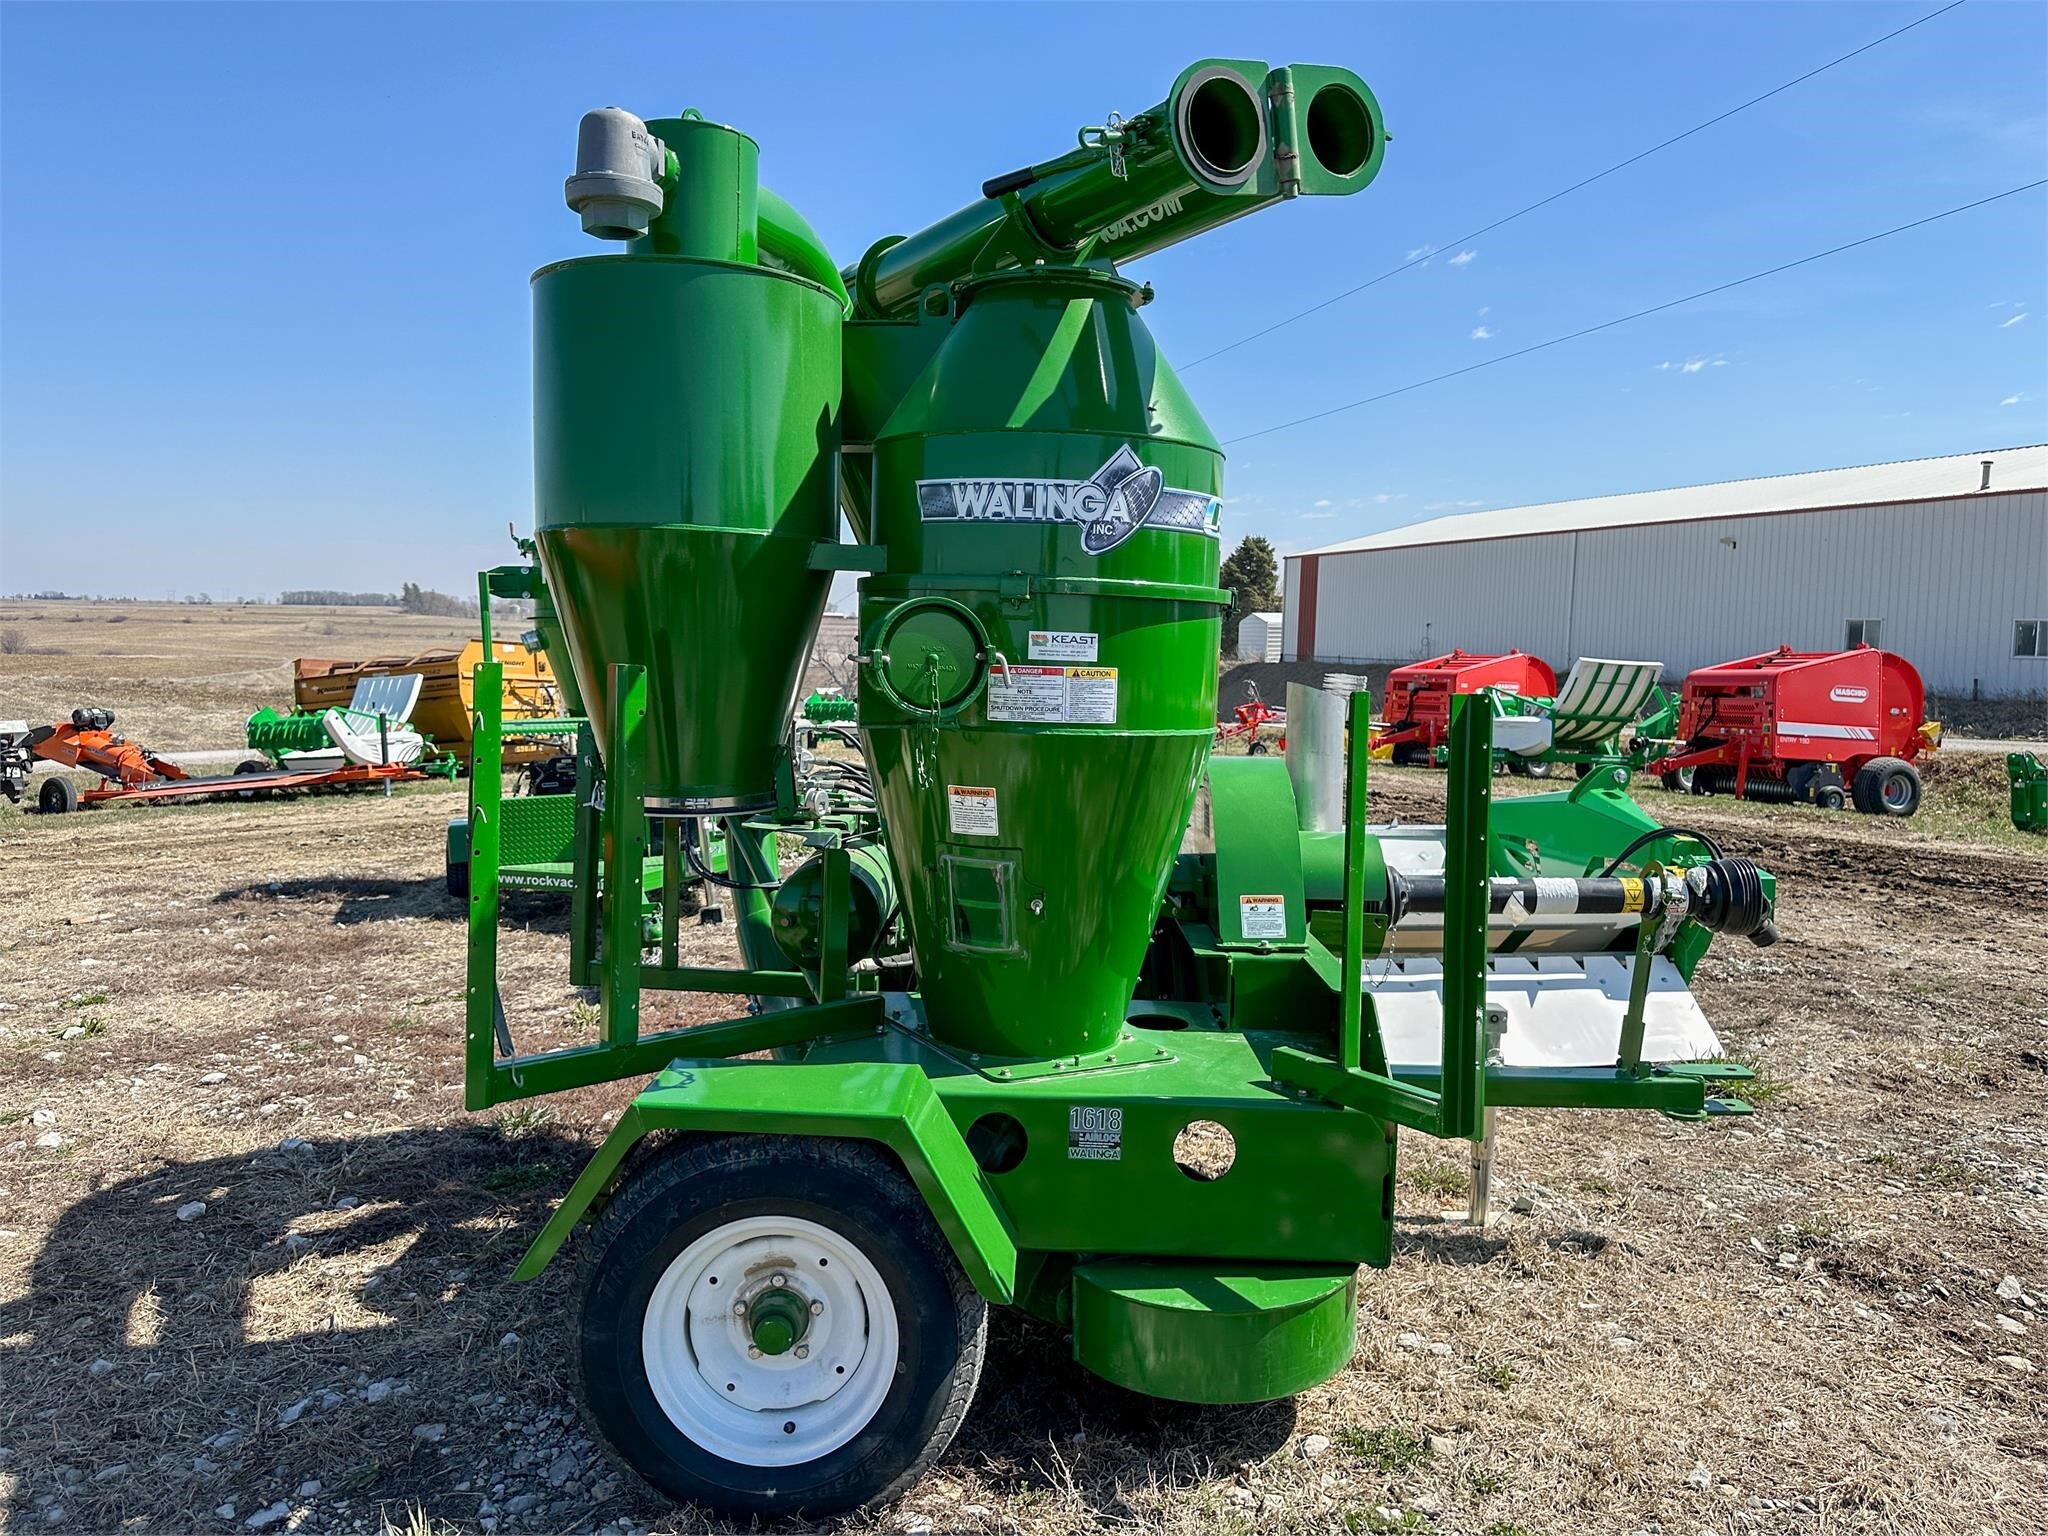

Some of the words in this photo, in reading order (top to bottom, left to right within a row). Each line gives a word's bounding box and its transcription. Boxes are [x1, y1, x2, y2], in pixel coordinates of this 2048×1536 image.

[953, 483, 1131, 524] WALINGA
[1092, 523, 1116, 536] INC.
[1051, 635, 1096, 645] KEAST
[1835, 688, 1867, 697] MASCHIO
[1779, 736, 1798, 744] ENTRY
[1070, 1106, 1122, 1131] 1618
[1084, 1133, 1121, 1143] AIRLOCK
[1069, 1148, 1120, 1159] WALINGA
